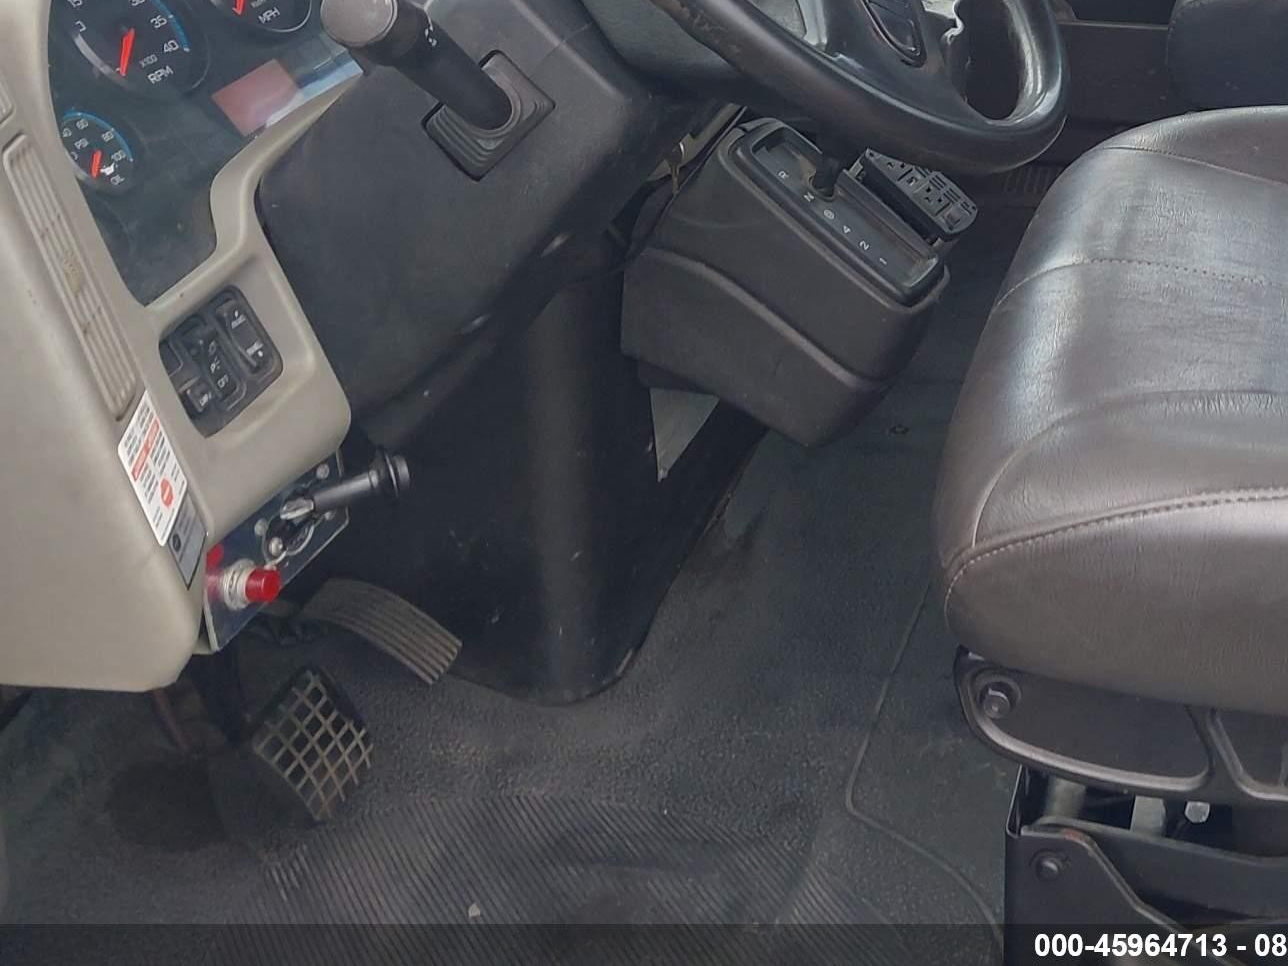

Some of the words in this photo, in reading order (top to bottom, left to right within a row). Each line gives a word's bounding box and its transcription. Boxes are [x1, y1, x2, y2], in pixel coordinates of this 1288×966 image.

[150, 14, 168, 29] 35
[258, 7, 281, 25] MPH
[162, 39, 180, 53] 40
[147, 65, 174, 84] RPM
[778, 170, 789, 180] R
[803, 192, 815, 202] N
[843, 225, 852, 234] 4
[859, 240, 870, 251] 2
